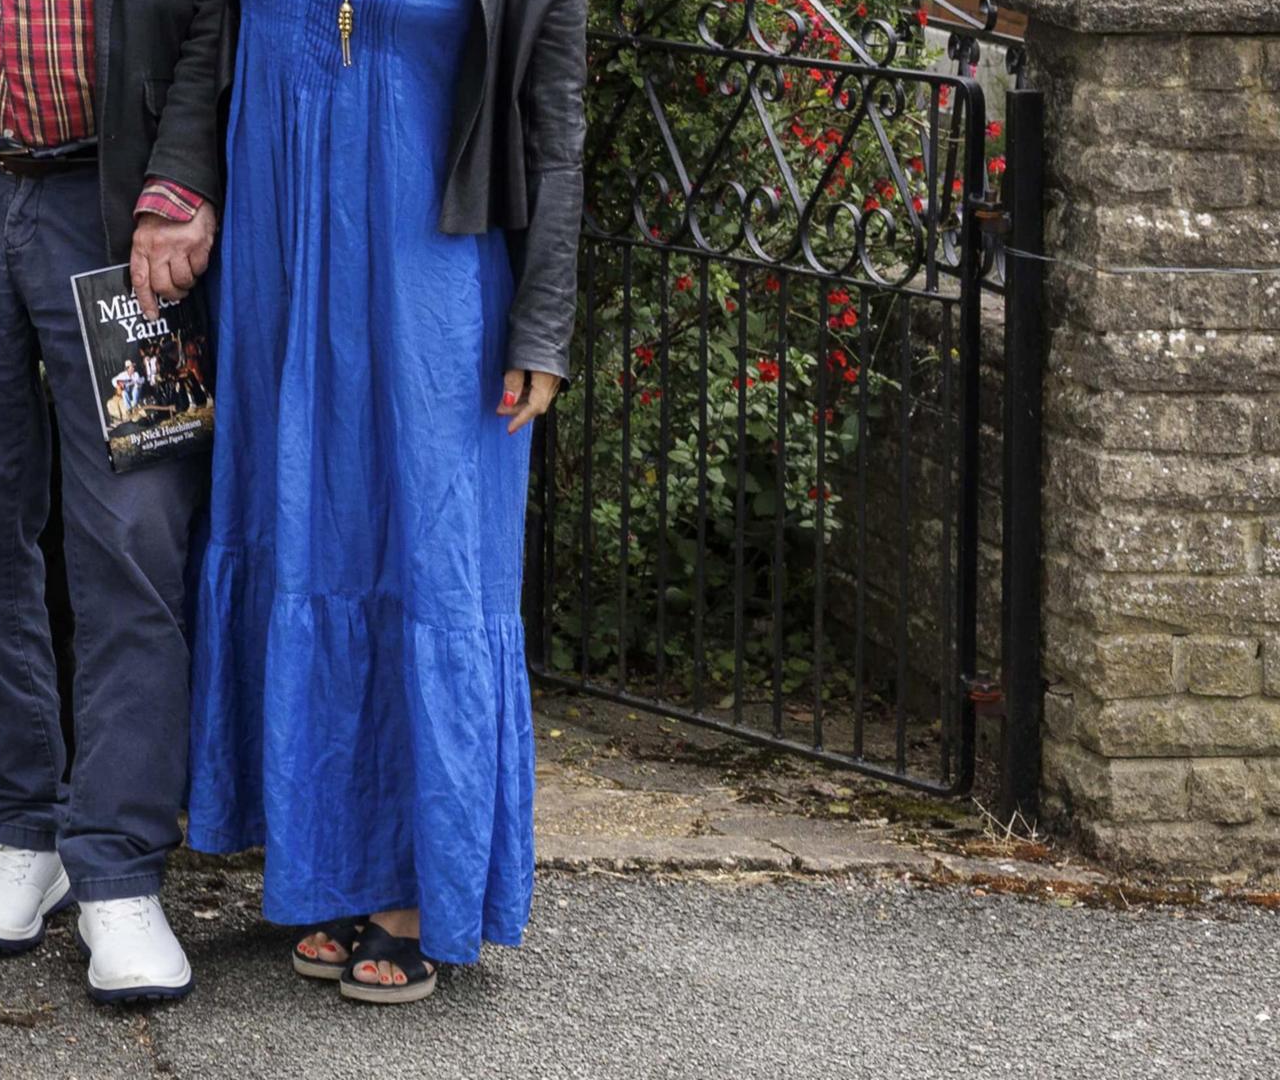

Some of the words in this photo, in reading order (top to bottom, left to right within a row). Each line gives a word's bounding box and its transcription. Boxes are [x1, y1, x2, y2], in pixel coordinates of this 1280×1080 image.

[118, 316, 171, 343] Yarn
[130, 433, 141, 446] By
[141, 427, 161, 441] Nick
